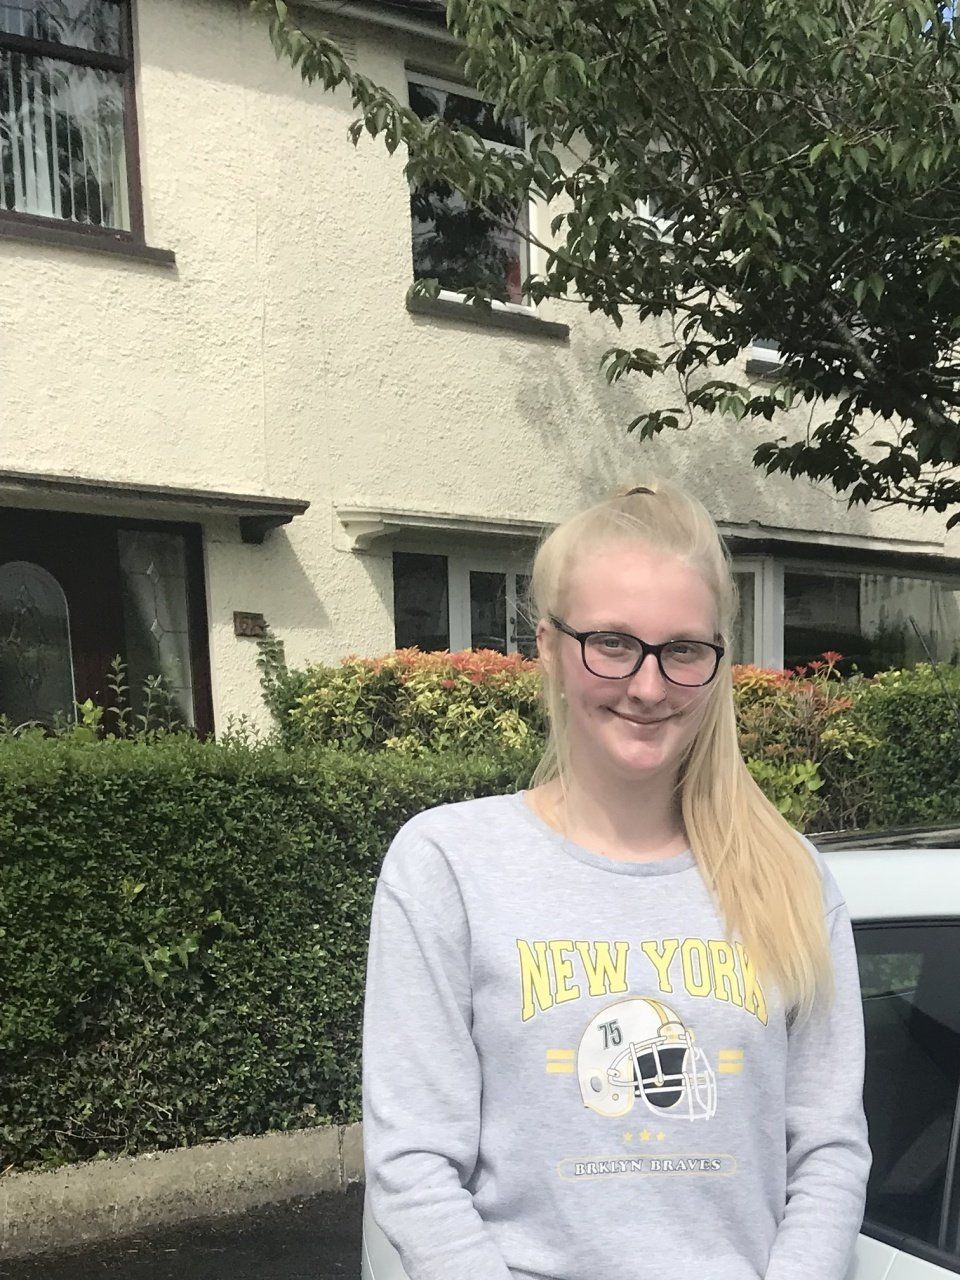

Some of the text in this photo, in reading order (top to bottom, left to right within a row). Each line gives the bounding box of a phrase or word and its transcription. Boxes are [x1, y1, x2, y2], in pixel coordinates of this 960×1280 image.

[516, 937, 768, 1026] NEW YORK
[597, 1018, 623, 1050] 75
[575, 1158, 722, 1176] BRKLYN BRAVES
